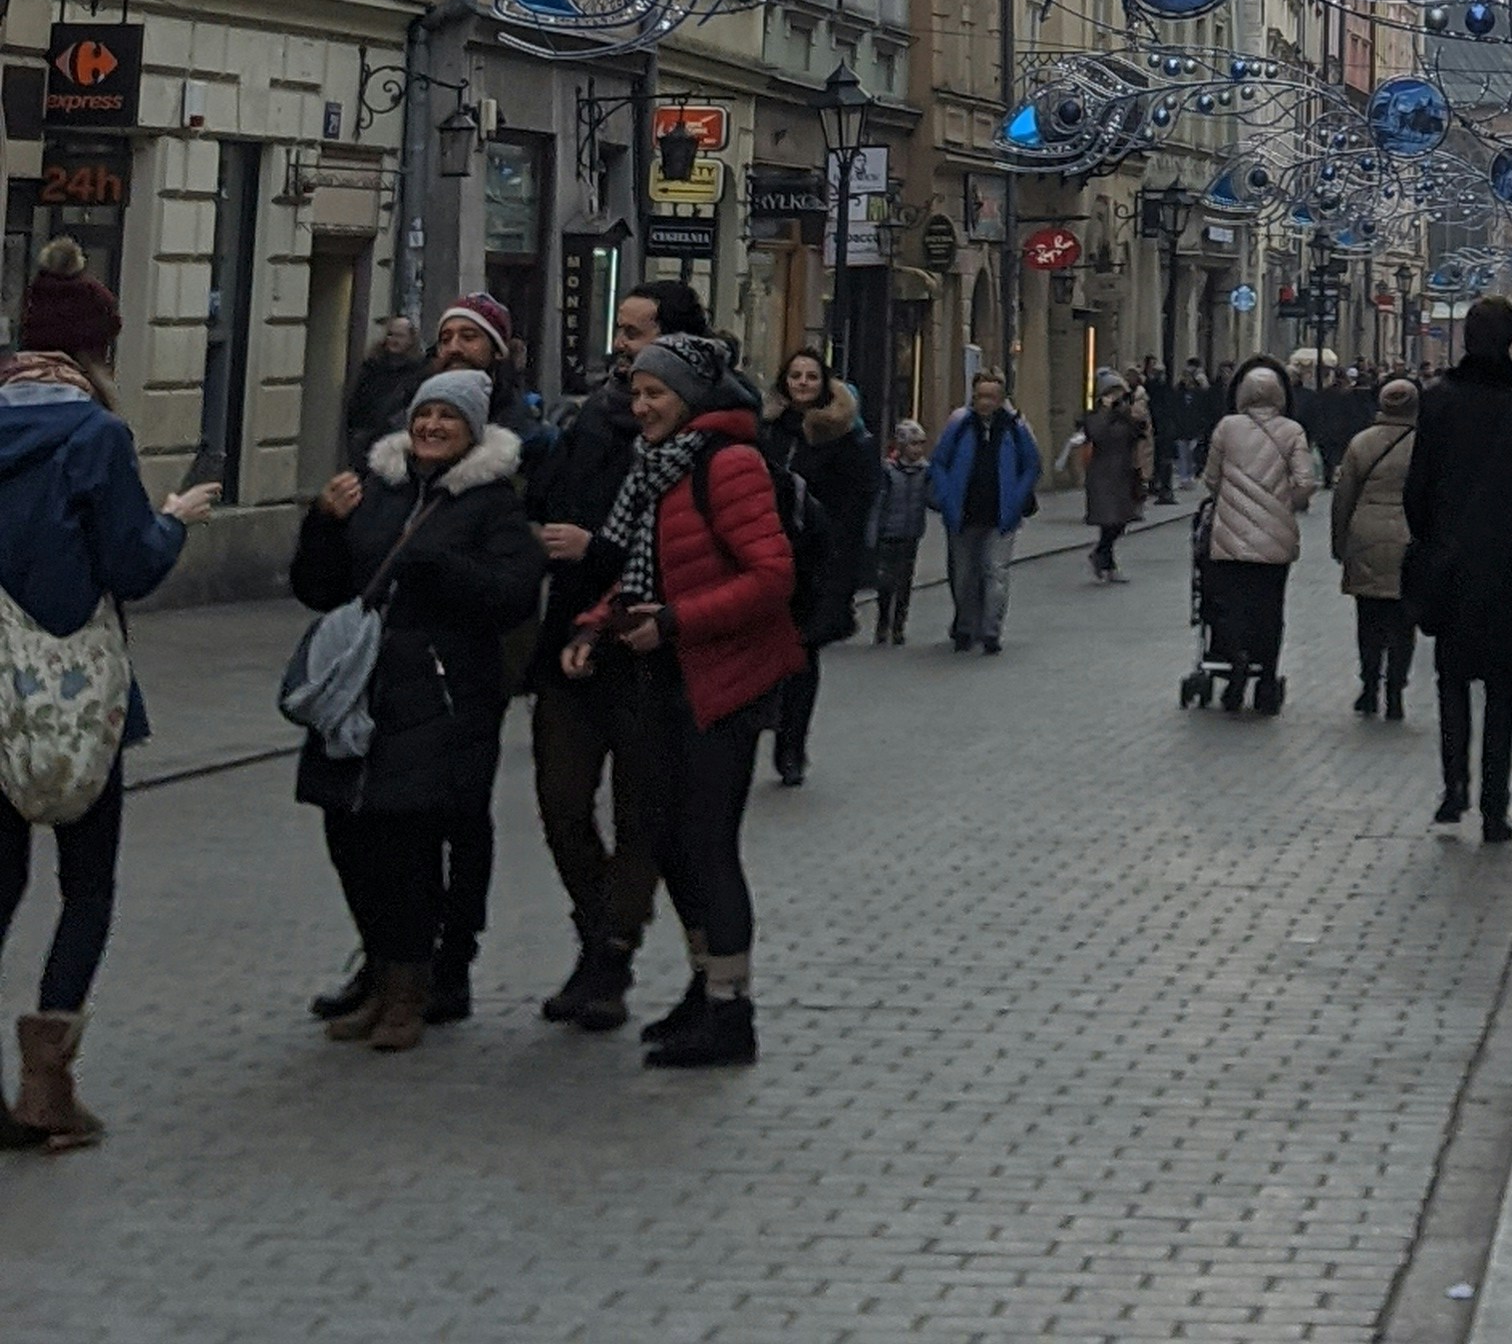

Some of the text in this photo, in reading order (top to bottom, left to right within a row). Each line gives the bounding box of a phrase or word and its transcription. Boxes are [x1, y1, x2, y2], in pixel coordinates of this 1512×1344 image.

[47, 94, 124, 113] express
[39, 164, 124, 204] 24h
[566, 256, 581, 368] MONETY
